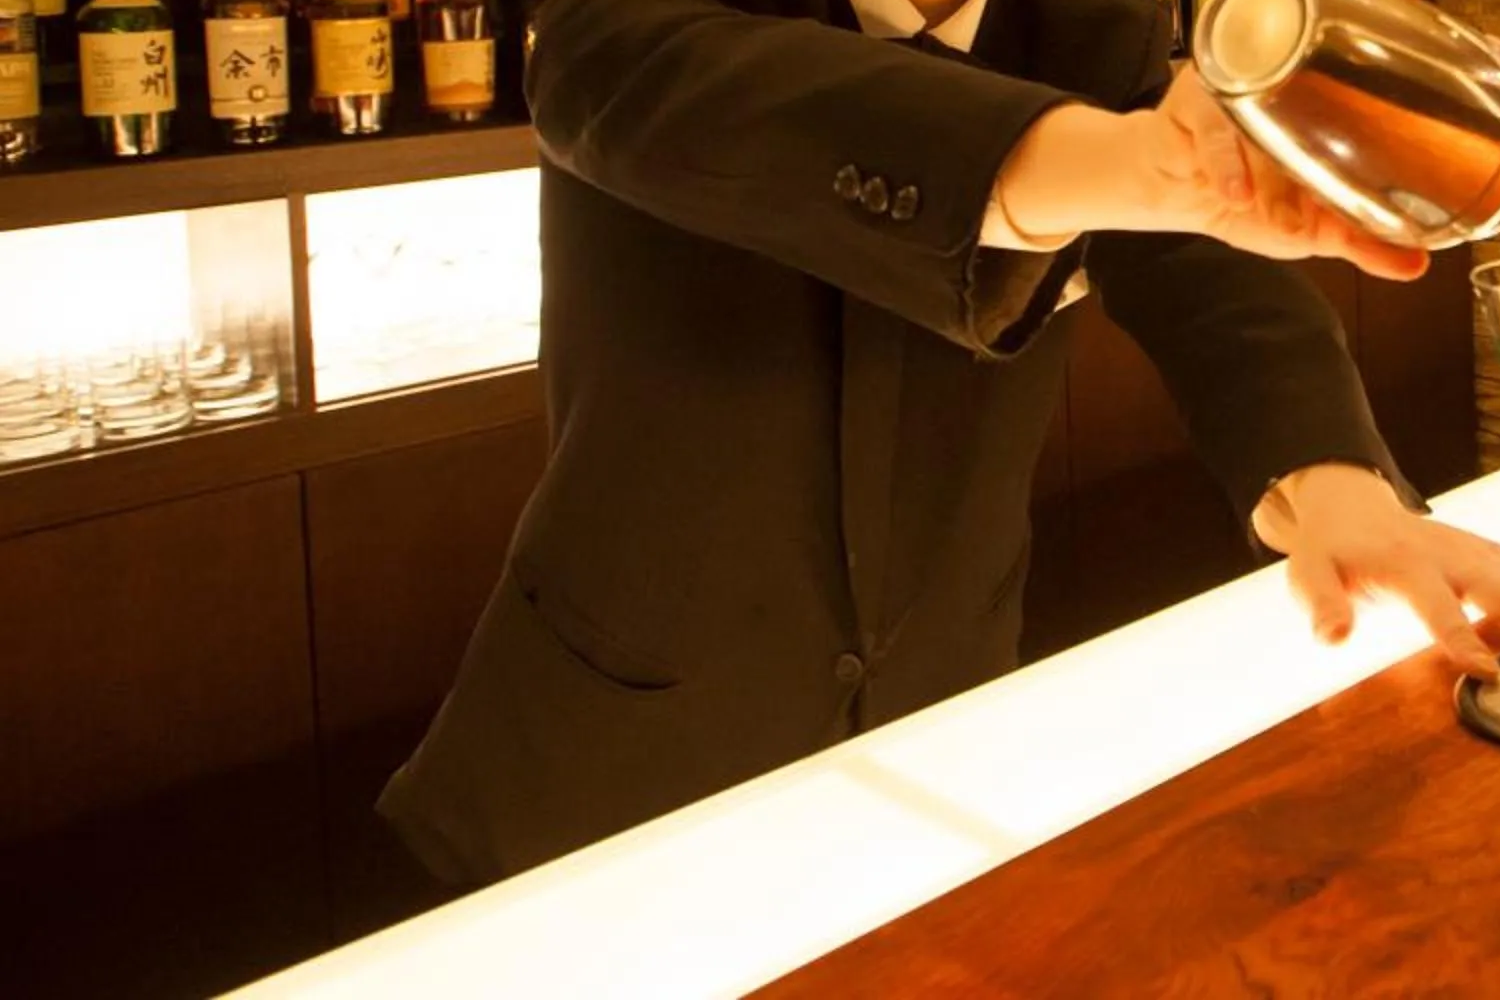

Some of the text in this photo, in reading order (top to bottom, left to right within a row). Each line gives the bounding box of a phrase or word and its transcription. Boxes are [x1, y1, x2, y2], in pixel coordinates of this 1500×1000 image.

[140, 39, 169, 97] 白州
[220, 45, 283, 79] 余市
[366, 27, 390, 79] 山崎
